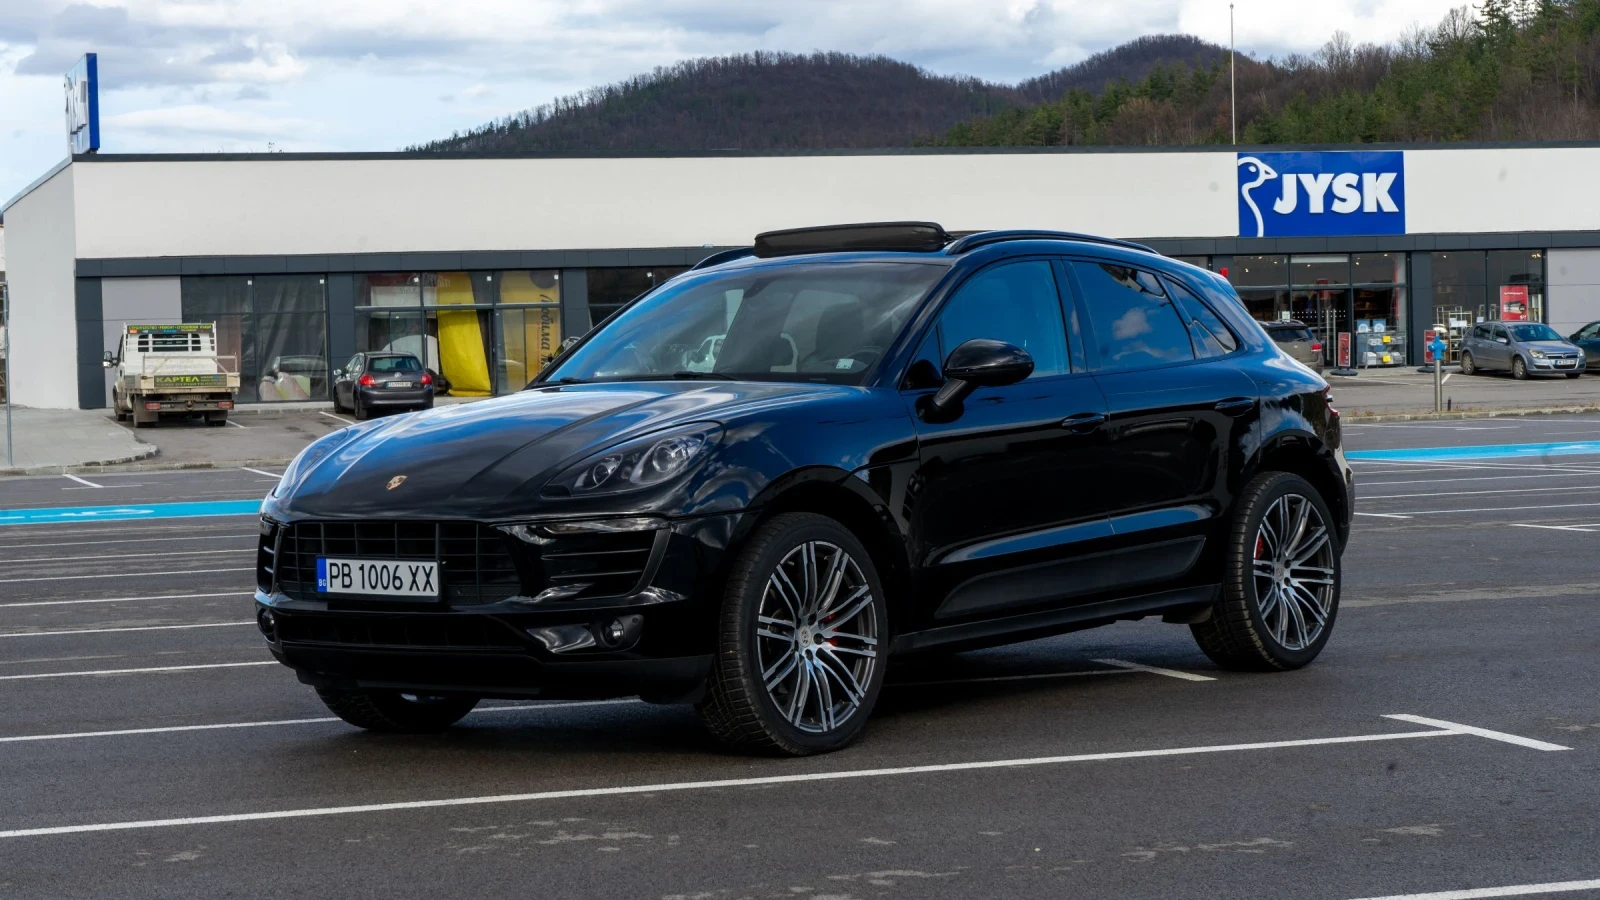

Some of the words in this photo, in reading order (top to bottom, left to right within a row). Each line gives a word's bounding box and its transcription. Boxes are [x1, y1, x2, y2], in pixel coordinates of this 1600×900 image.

[1273, 173, 1399, 214] JYSK
[318, 579, 326, 587] BG
[329, 562, 352, 588] PB
[358, 563, 403, 590] 1006
[408, 565, 434, 592] XX
